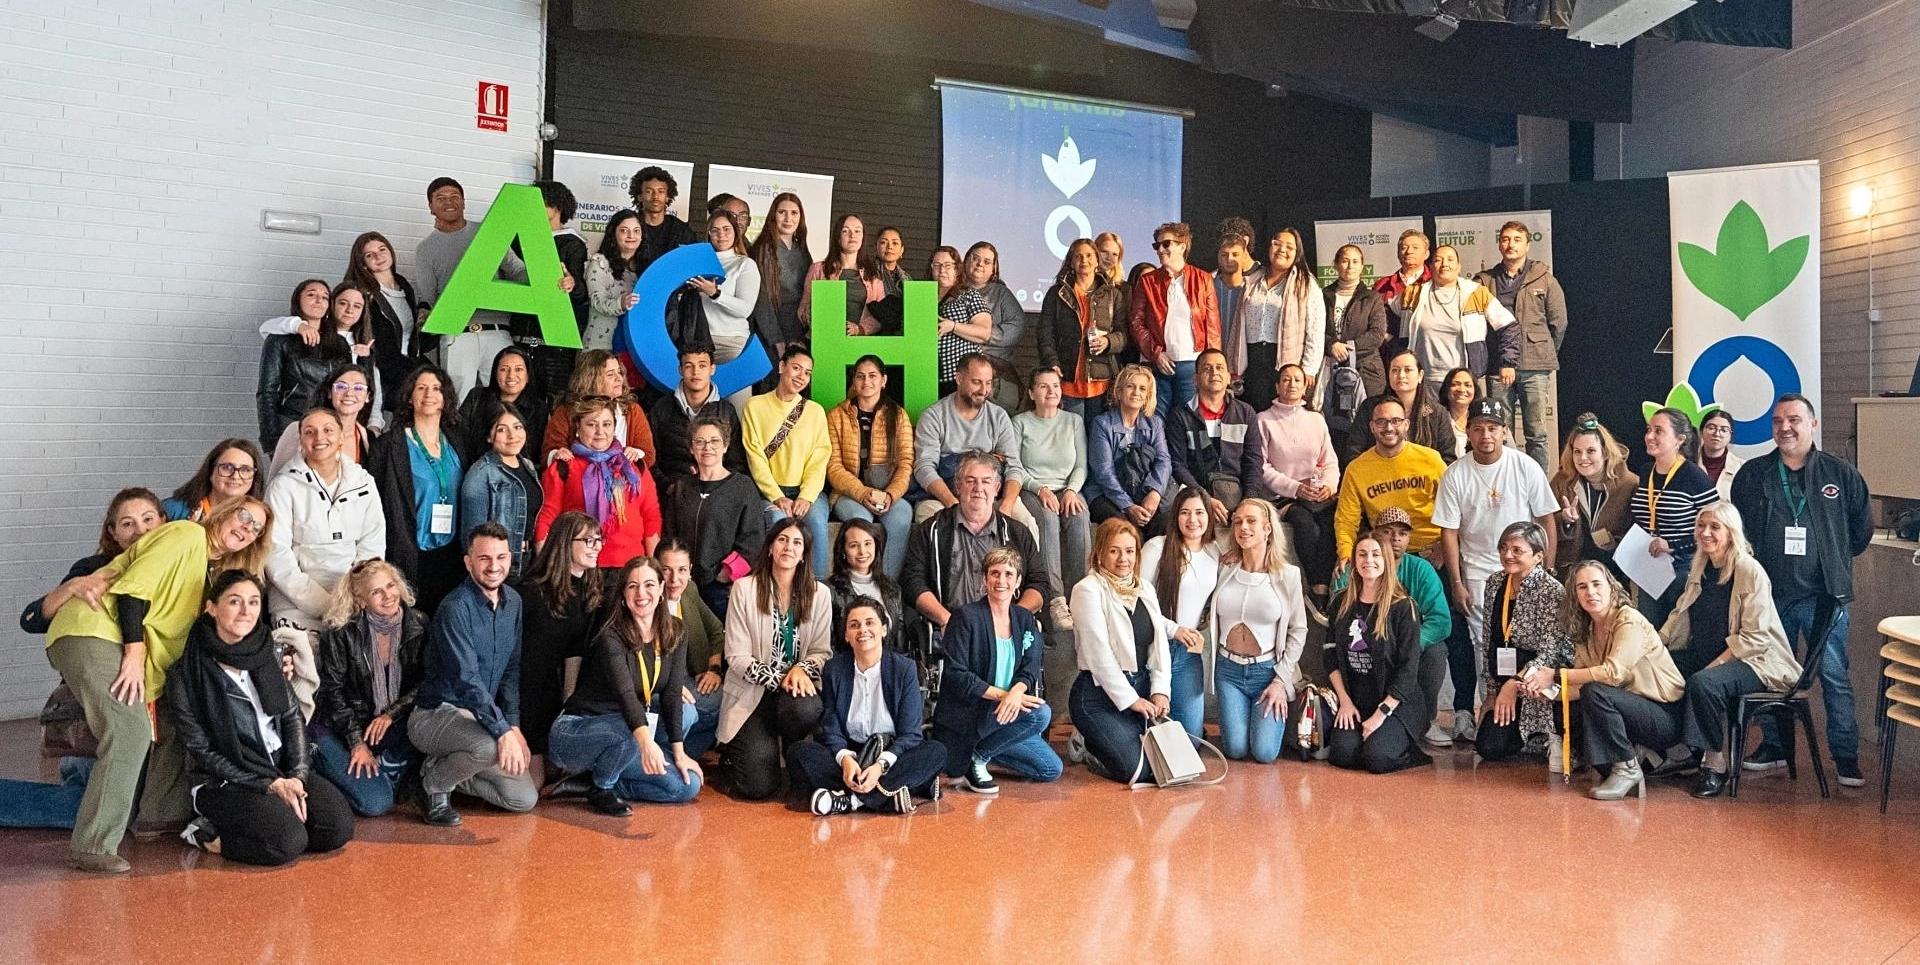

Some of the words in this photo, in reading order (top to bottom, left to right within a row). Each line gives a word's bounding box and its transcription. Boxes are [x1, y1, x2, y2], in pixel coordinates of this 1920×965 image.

[747, 184, 771, 192] VIVES
[1438, 235, 1475, 247] FUTUR
[1367, 475, 1426, 499] CHEVIGNON
